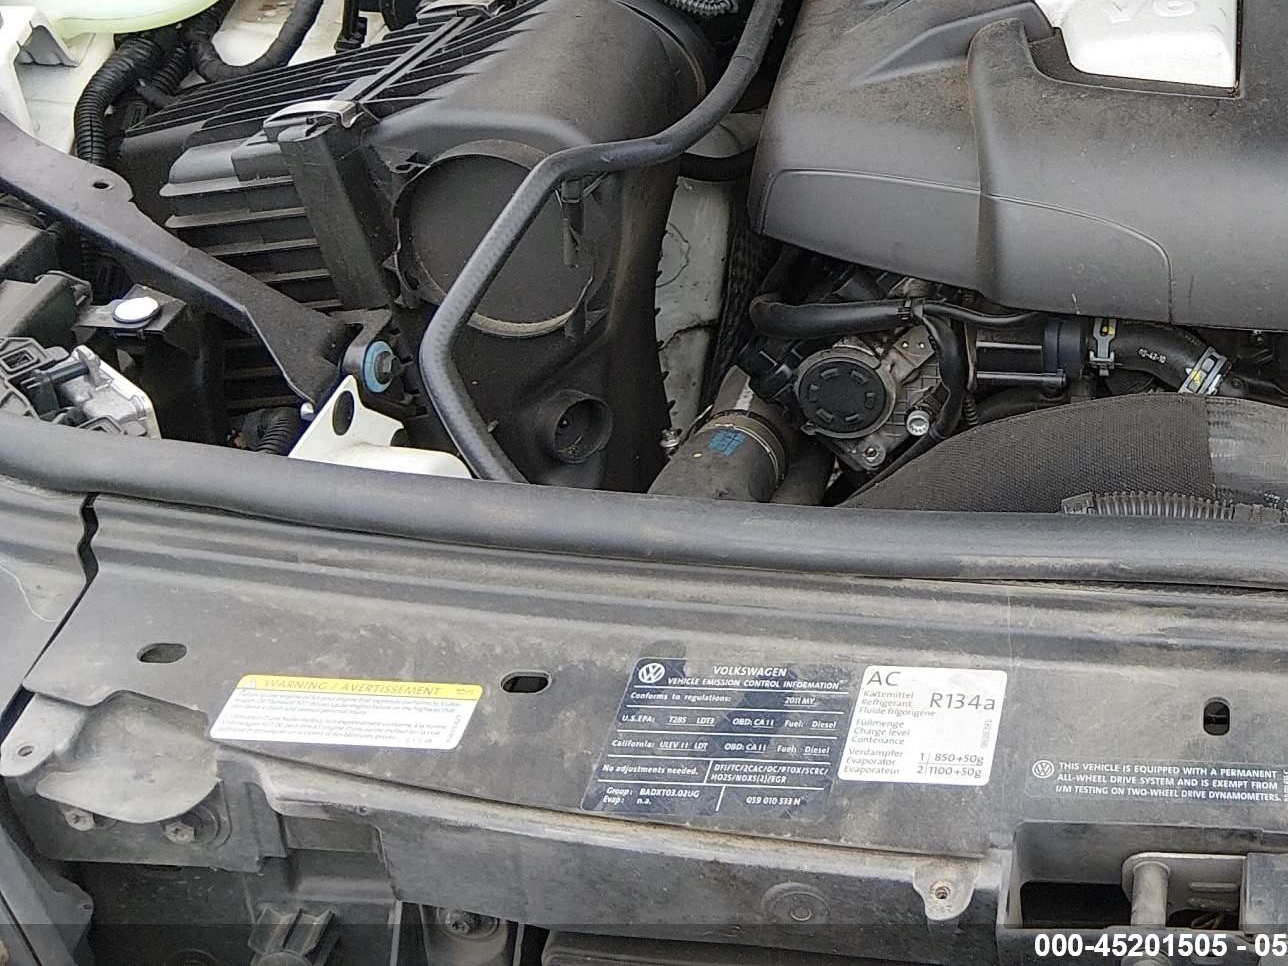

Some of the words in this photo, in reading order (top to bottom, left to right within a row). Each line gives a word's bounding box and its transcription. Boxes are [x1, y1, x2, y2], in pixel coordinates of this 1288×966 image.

[712, 664, 787, 678] VOLKSWAGEN
[666, 677, 699, 685] VEHICLE
[701, 678, 740, 687] EMISSION
[743, 678, 780, 687] CONTROL
[782, 680, 839, 690] INFORMATION
[866, 670, 901, 686] AC
[262, 680, 329, 690] WARNING
[339, 683, 442, 696] AVERTISSEMENT
[629, 691, 668, 700] Conforms
[683, 692, 731, 703] regulations:
[860, 698, 912, 708] Refrigerant
[929, 692, 996, 710] R134a
[858, 706, 886, 714] Fluide
[783, 719, 804, 727] Fuel:
[811, 720, 837, 729] Diesel
[854, 718, 905, 729] Füllmenge
[852, 727, 887, 737] Charge
[850, 735, 905, 744] Contenance
[611, 738, 656, 748] California:
[693, 741, 708, 749] LDT
[804, 745, 829, 754] Diesel
[846, 747, 903, 759] Verdampfer
[845, 757, 896, 766] Evaporator
[601, 763, 616, 772] No
[614, 763, 666, 775] adjustments
[667, 765, 700, 775] needed.
[843, 766, 900, 776] Evaporateur
[1058, 761, 1079, 770] THIS
[1081, 762, 1119, 772] VEHICLE
[1122, 764, 1130, 772] IS
[1133, 764, 1180, 774] EQUIPPED
[1182, 766, 1207, 775] WITH
[1210, 767, 1217, 776] A
[1219, 768, 1277, 778] PERMANENT
[1056, 773, 1107, 783] ALL-WHEEL
[1109, 775, 1136, 784] DRIVE
[1139, 776, 1174, 785] SYSTEM
[1177, 778, 1198, 786] AND
[1200, 778, 1209, 787] IS
[1212, 779, 1248, 788] EXEMPT
[1250, 781, 1277, 789] FROM
[1055, 784, 1072, 793] I/M
[1074, 785, 1108, 794] TESTING
[1110, 787, 1124, 795] ON
[1126, 787, 1178, 797] TWO-WHEEL
[1180, 790, 1206, 798] DRIVE
[1208, 791, 1281, 801] DYNAMOMETERS.
